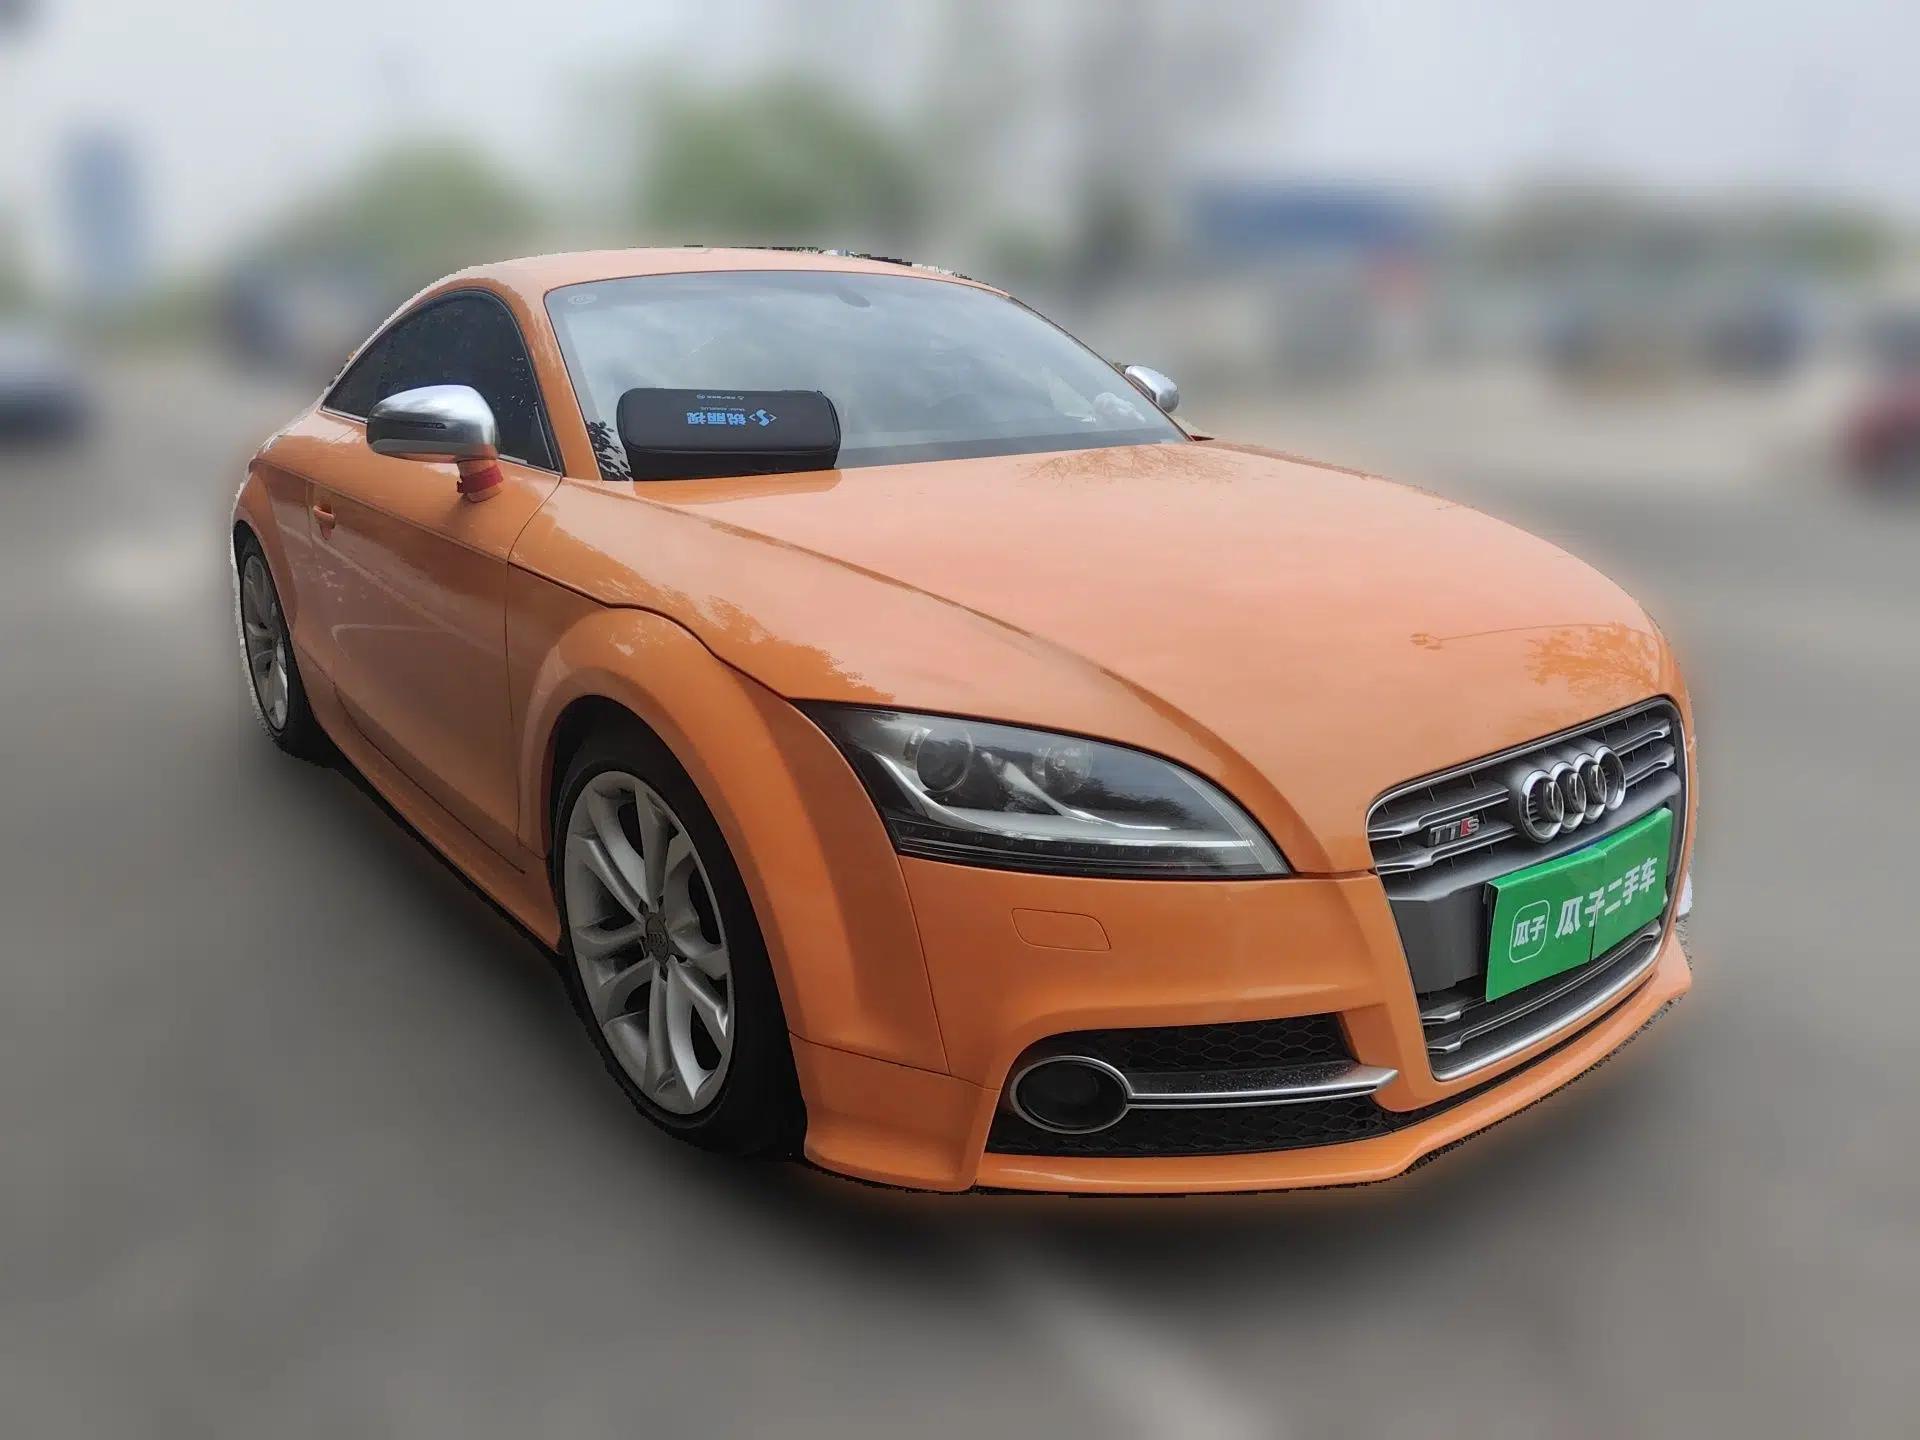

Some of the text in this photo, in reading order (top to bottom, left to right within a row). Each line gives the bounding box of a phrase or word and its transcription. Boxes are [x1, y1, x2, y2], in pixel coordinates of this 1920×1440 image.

[1430, 818, 1480, 845] TTS
[1555, 857, 1657, 938] 瓜子二手车
[1513, 914, 1545, 947] 瓜子
